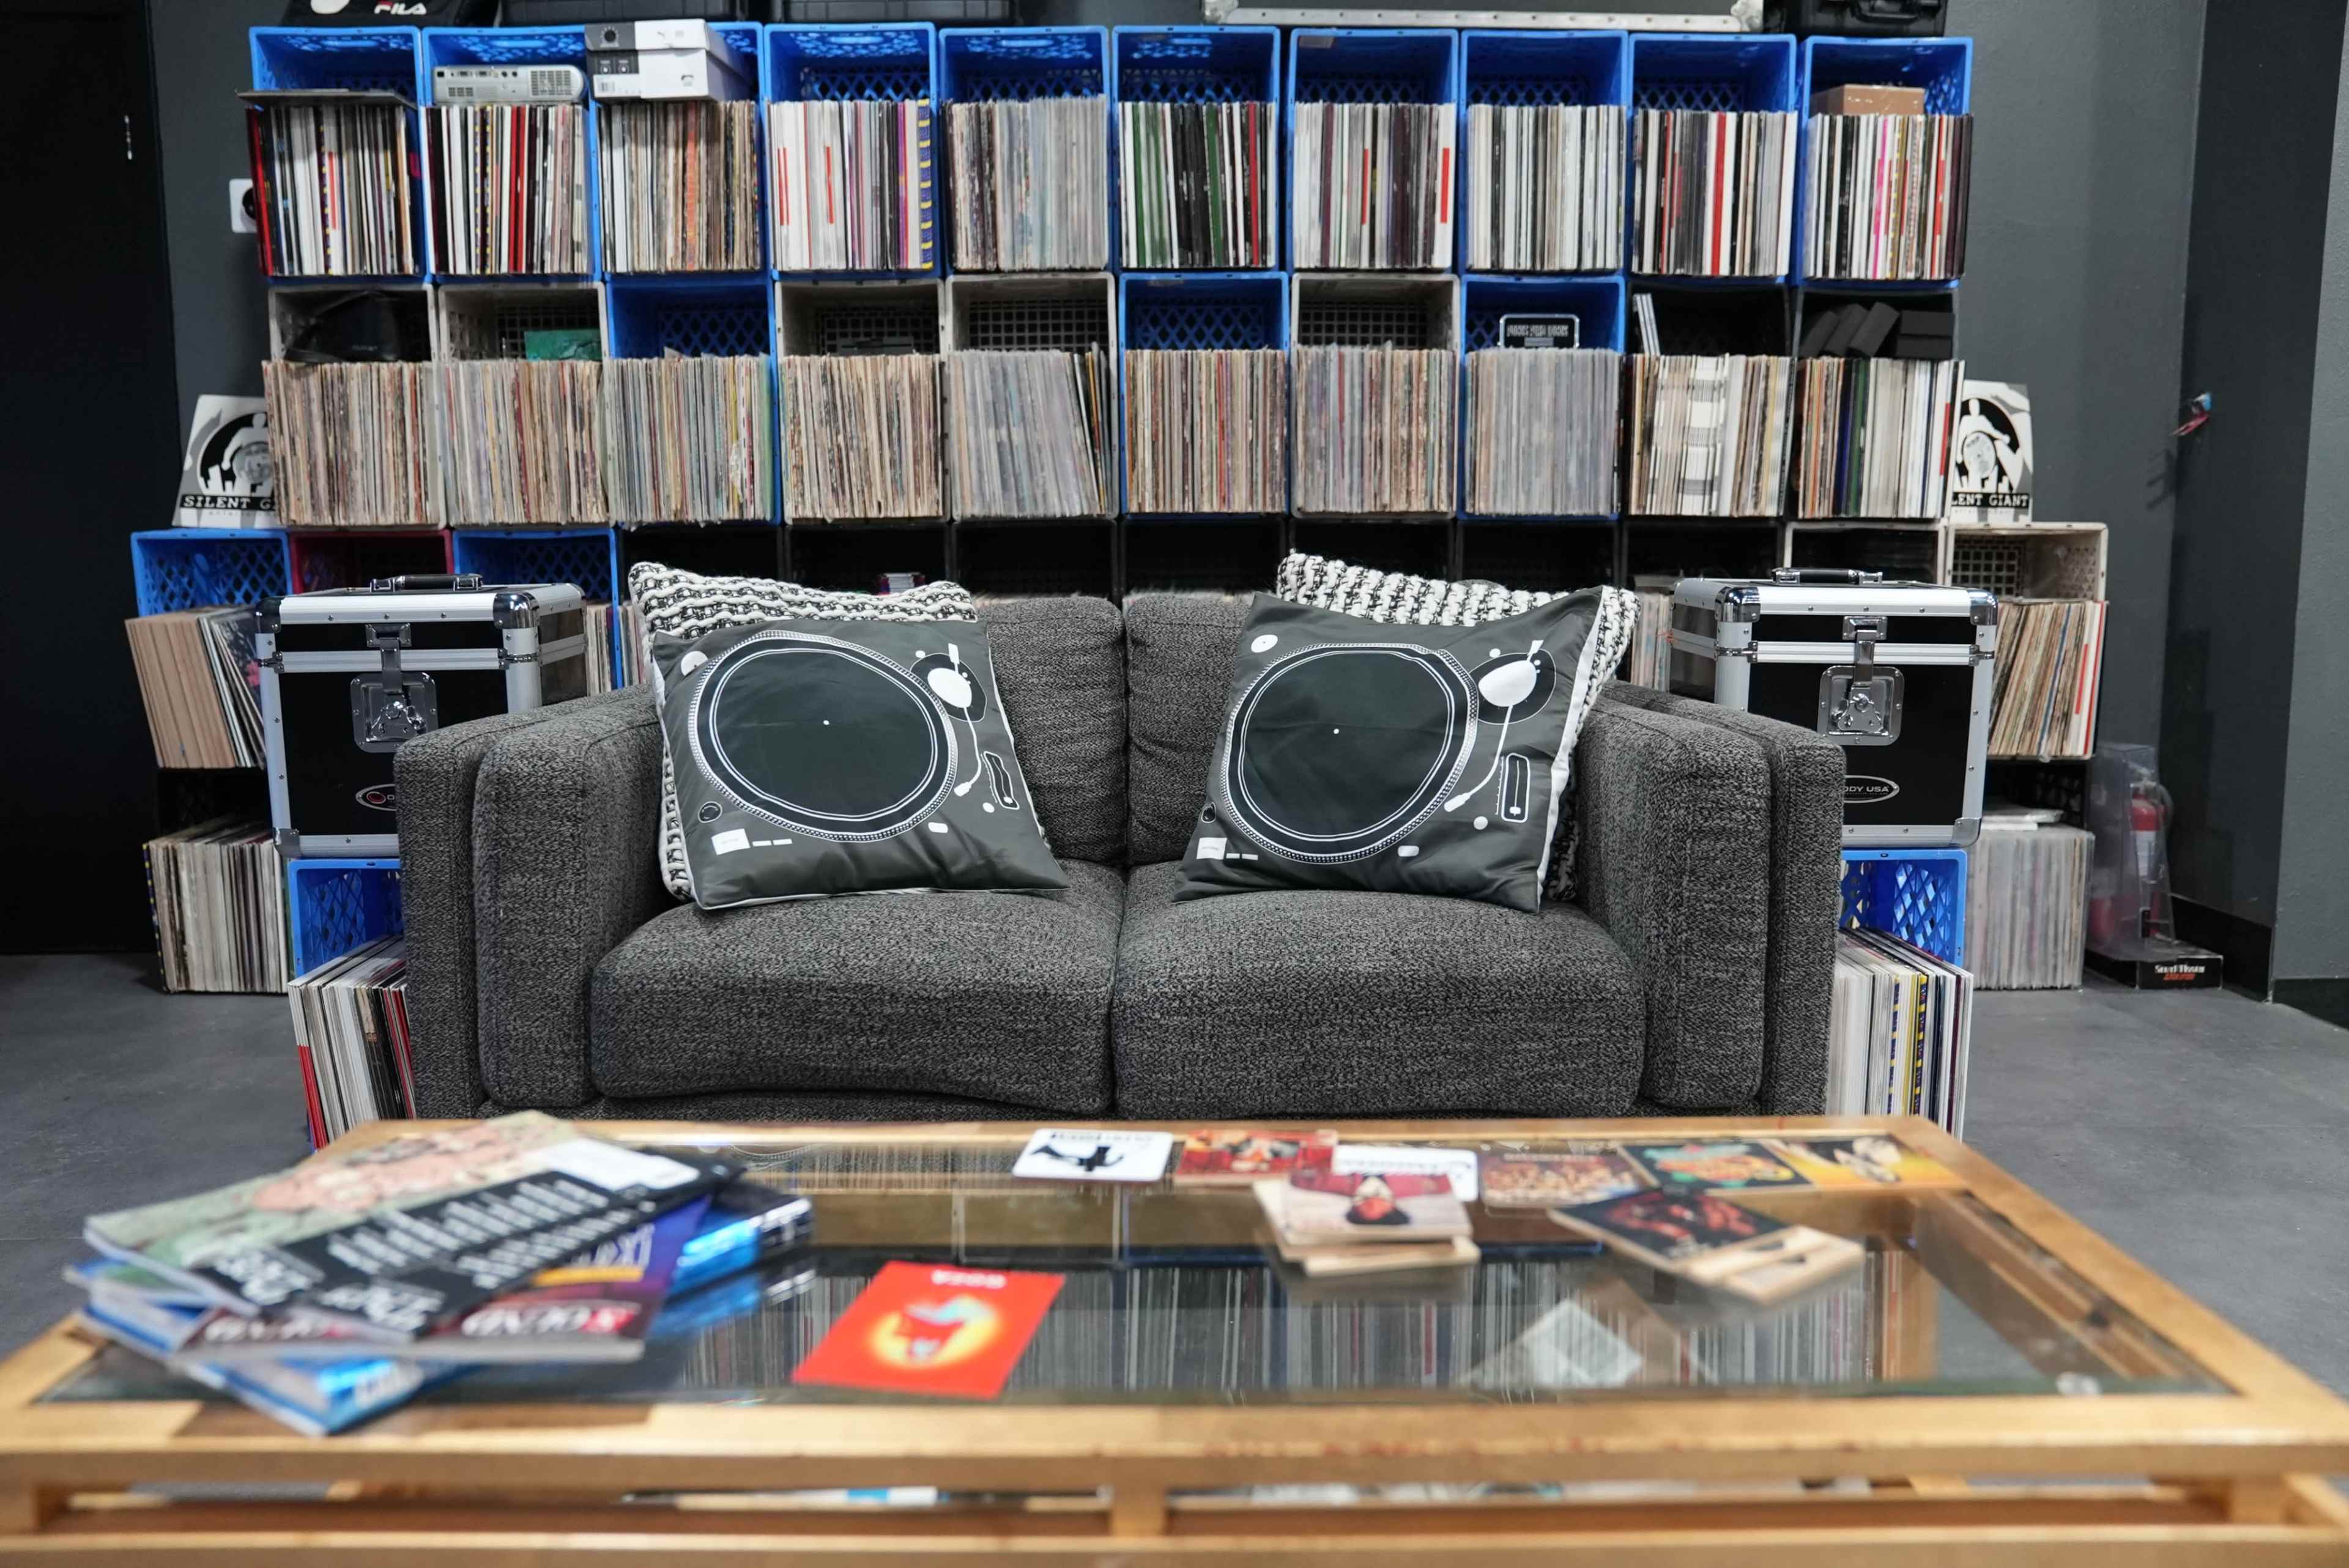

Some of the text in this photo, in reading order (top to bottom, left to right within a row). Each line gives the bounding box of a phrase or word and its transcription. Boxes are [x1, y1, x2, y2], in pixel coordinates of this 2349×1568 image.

[374, 1, 427, 15] FILA
[184, 495, 251, 509] SILENT
[1989, 494, 2028, 507] GIANT
